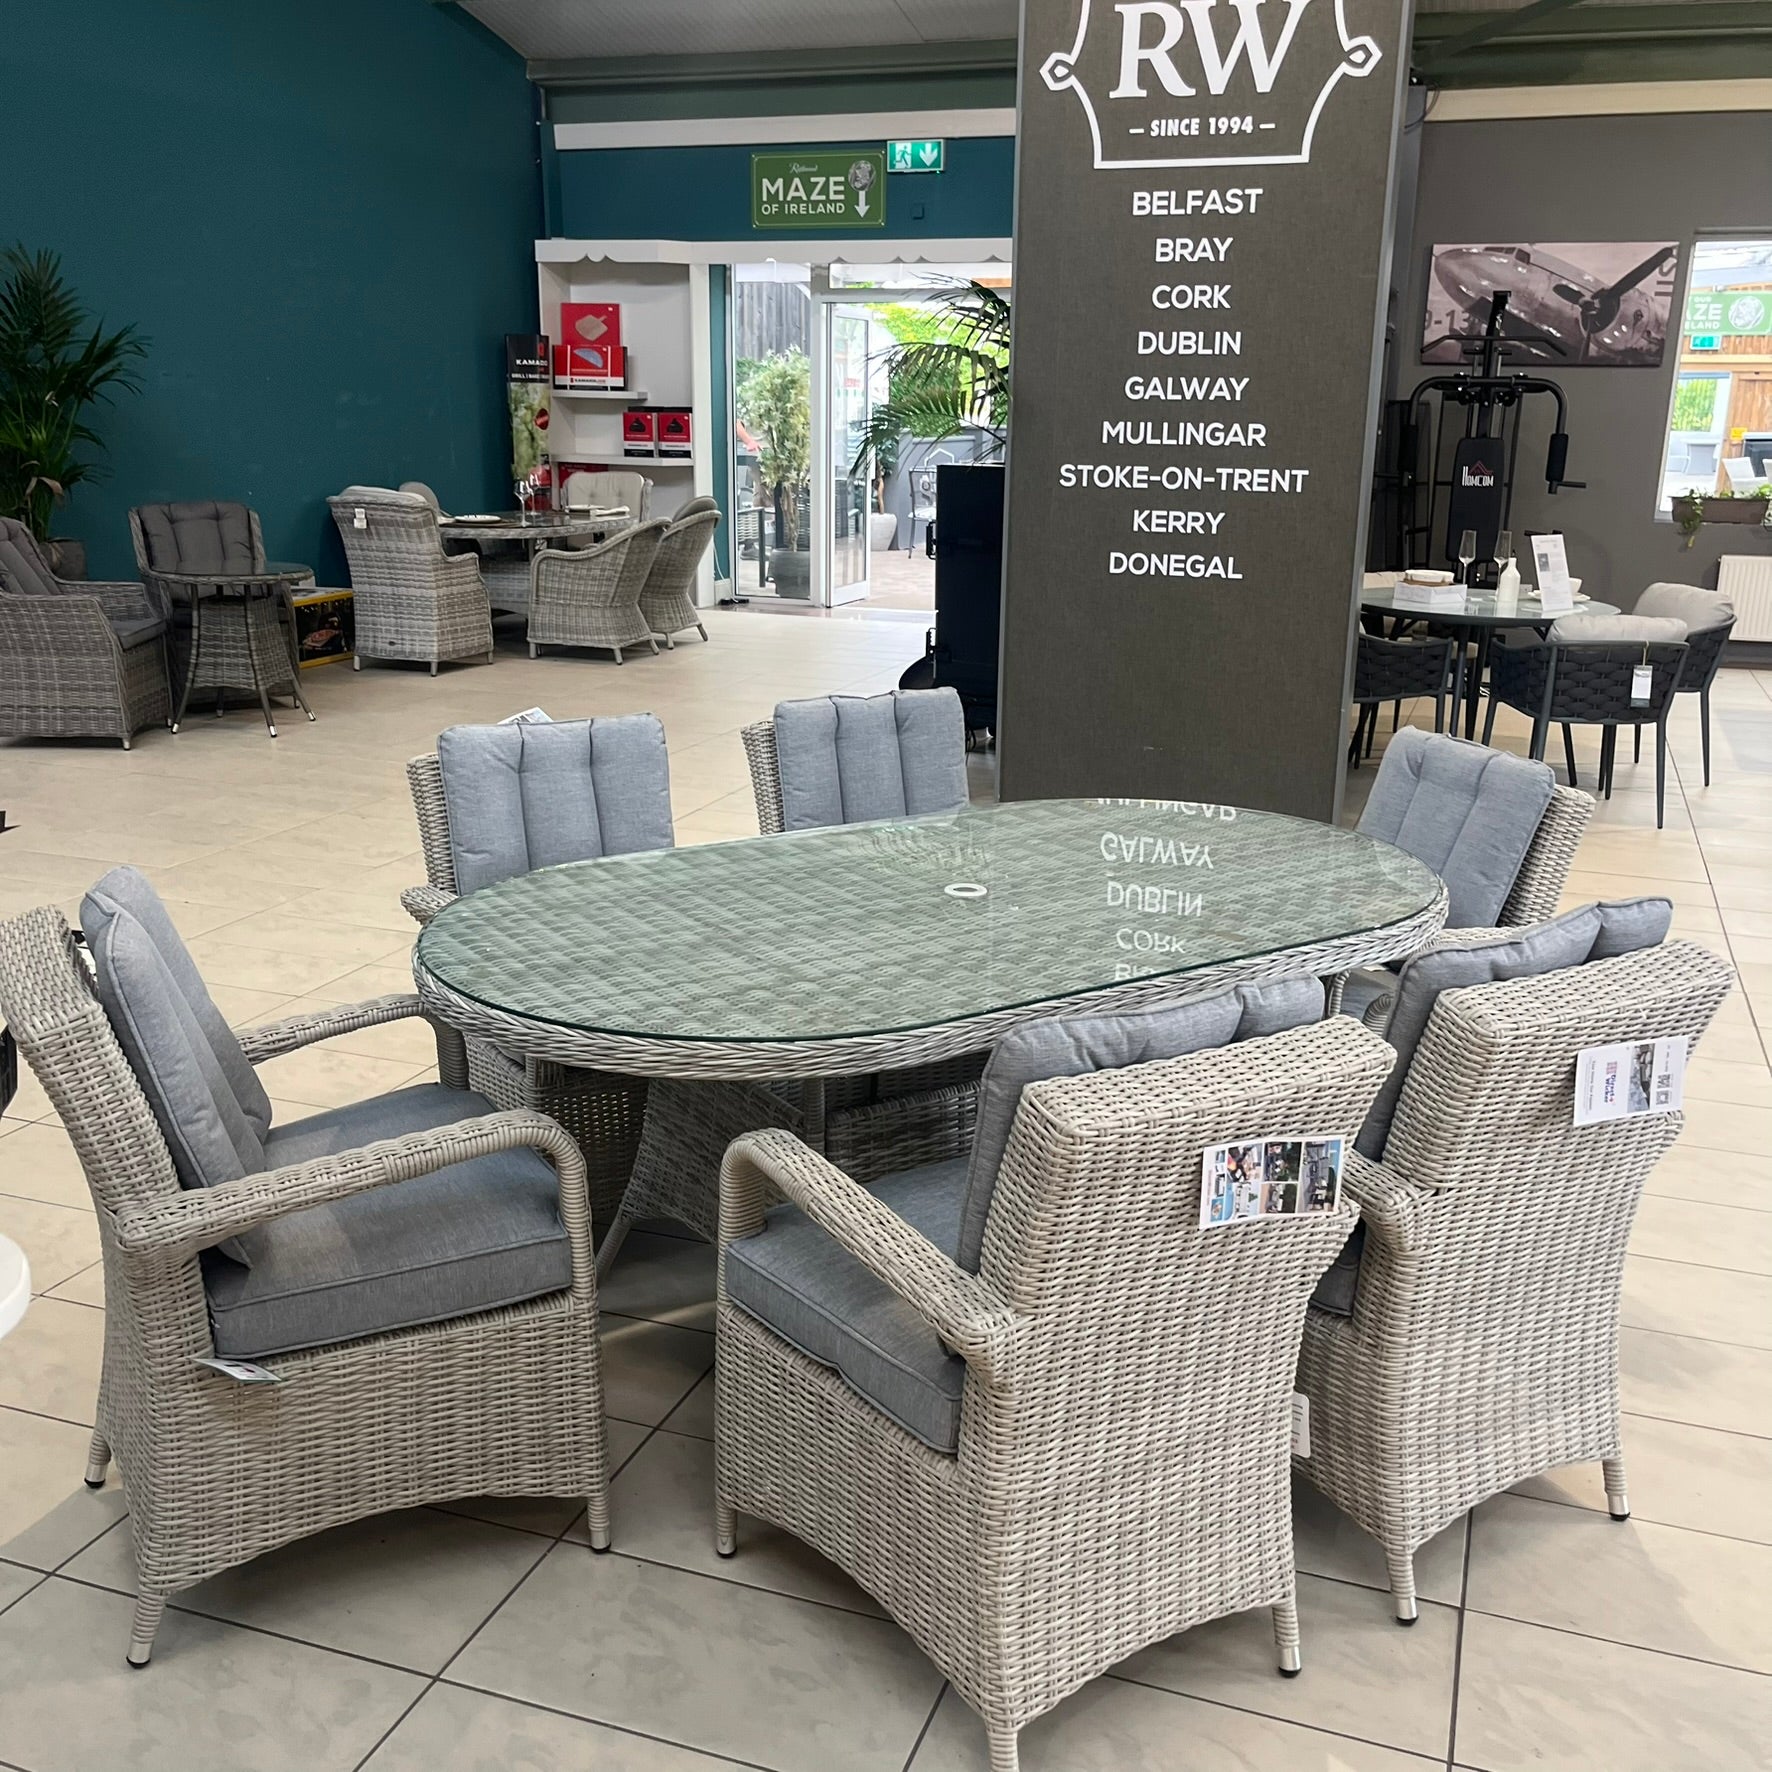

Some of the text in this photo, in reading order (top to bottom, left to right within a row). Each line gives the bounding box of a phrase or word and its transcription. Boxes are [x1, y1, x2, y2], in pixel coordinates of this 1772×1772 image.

[1109, 0, 1311, 98] RW
[1150, 116, 1254, 137] SINCE 1994
[761, 176, 846, 202] MAZE
[1132, 188, 1263, 215] BELFAST
[761, 202, 846, 215] OF IRELAND
[1155, 237, 1233, 262] BRAY
[1152, 284, 1232, 309] CORK
[1137, 331, 1242, 355] DUBLIN
[1124, 376, 1250, 401] GALWAY
[1102, 421, 1267, 446] MULLINGAR
[1059, 464, 1309, 493] STOKE-ON-TRENT
[1133, 510, 1226, 534] KERRY
[1109, 552, 1243, 579] DONEGAL
